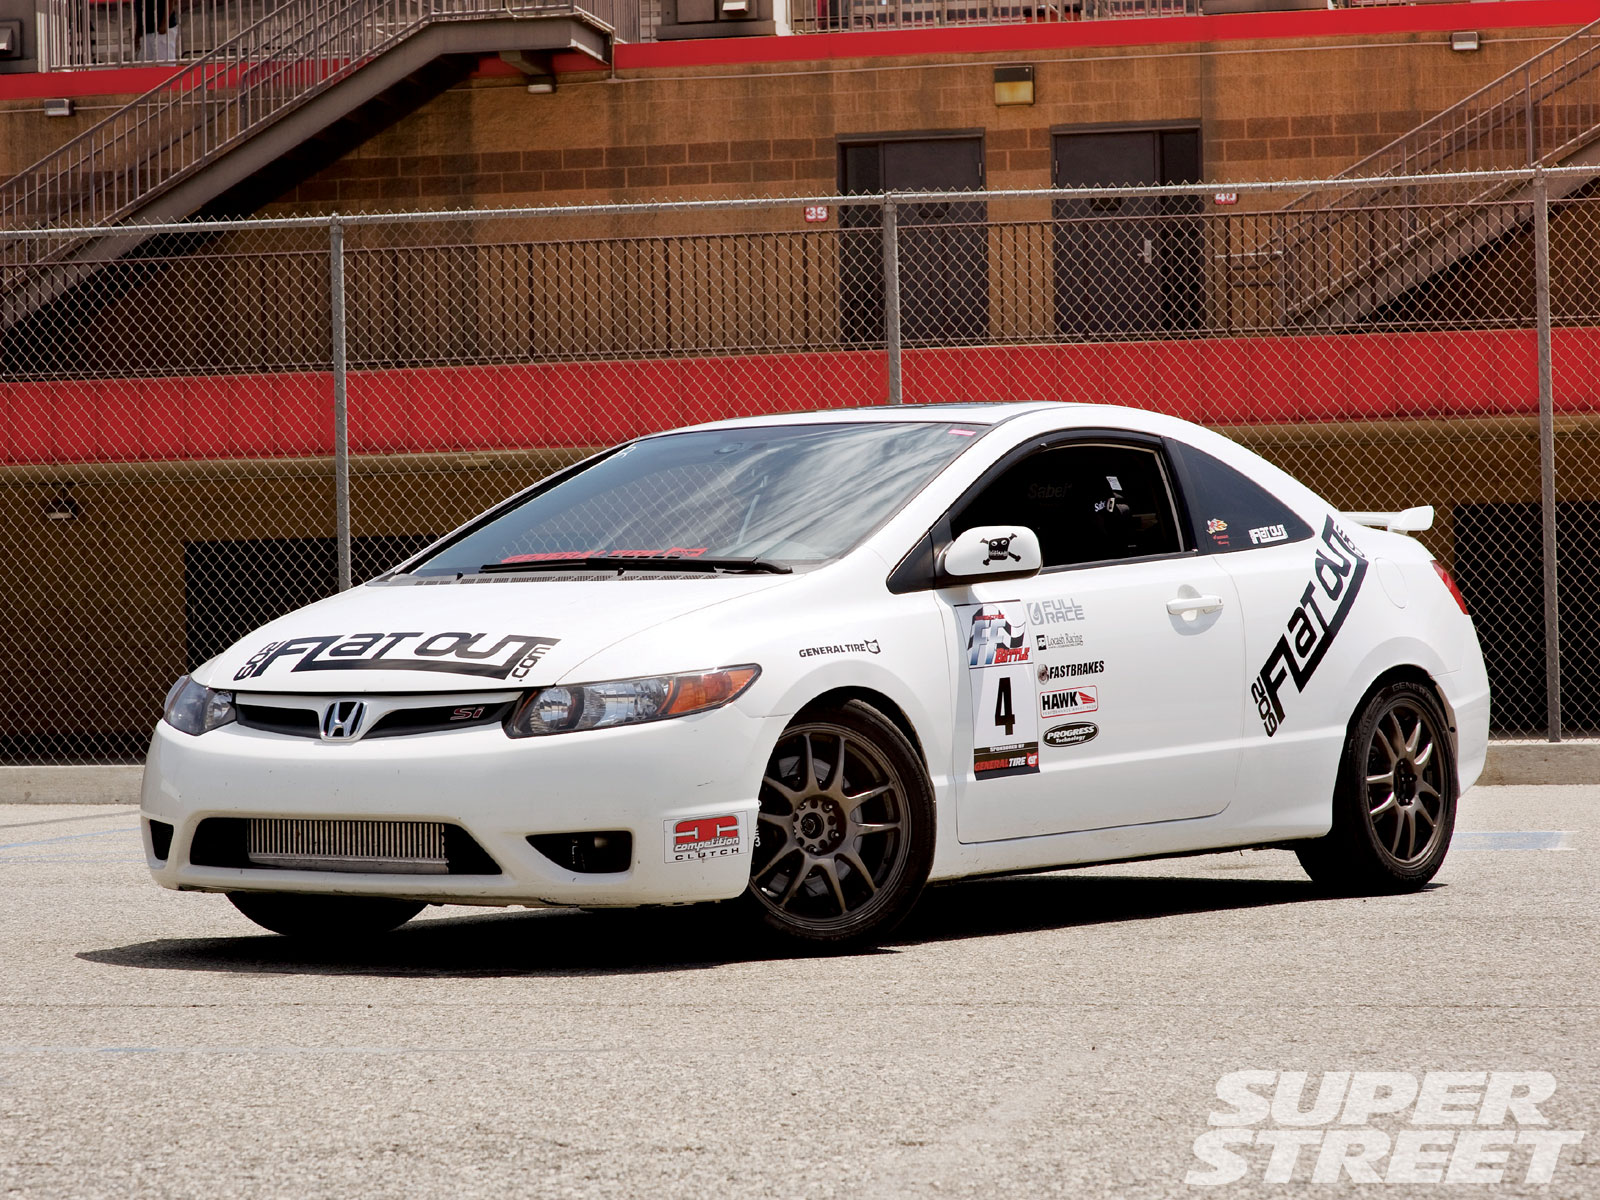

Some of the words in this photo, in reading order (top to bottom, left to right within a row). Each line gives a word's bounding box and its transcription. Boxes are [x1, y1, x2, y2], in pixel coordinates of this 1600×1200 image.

[1042, 598, 1083, 612] FULL
[1045, 608, 1085, 624] RACE
[799, 645, 845, 658] GENERAL
[845, 643, 867, 653] TIRE
[994, 647, 1031, 664] BATTLE
[1049, 660, 1105, 680] FASTBRAKES
[994, 677, 1016, 736] 4
[1042, 691, 1079, 711] HAWK
[1046, 726, 1095, 740] PROGRESS
[1055, 735, 1086, 744] Technology
[975, 758, 1009, 772] GENERAL
[1009, 756, 1026, 767] TIRE
[674, 837, 740, 852] competition
[674, 847, 740, 861] CLUTCH
